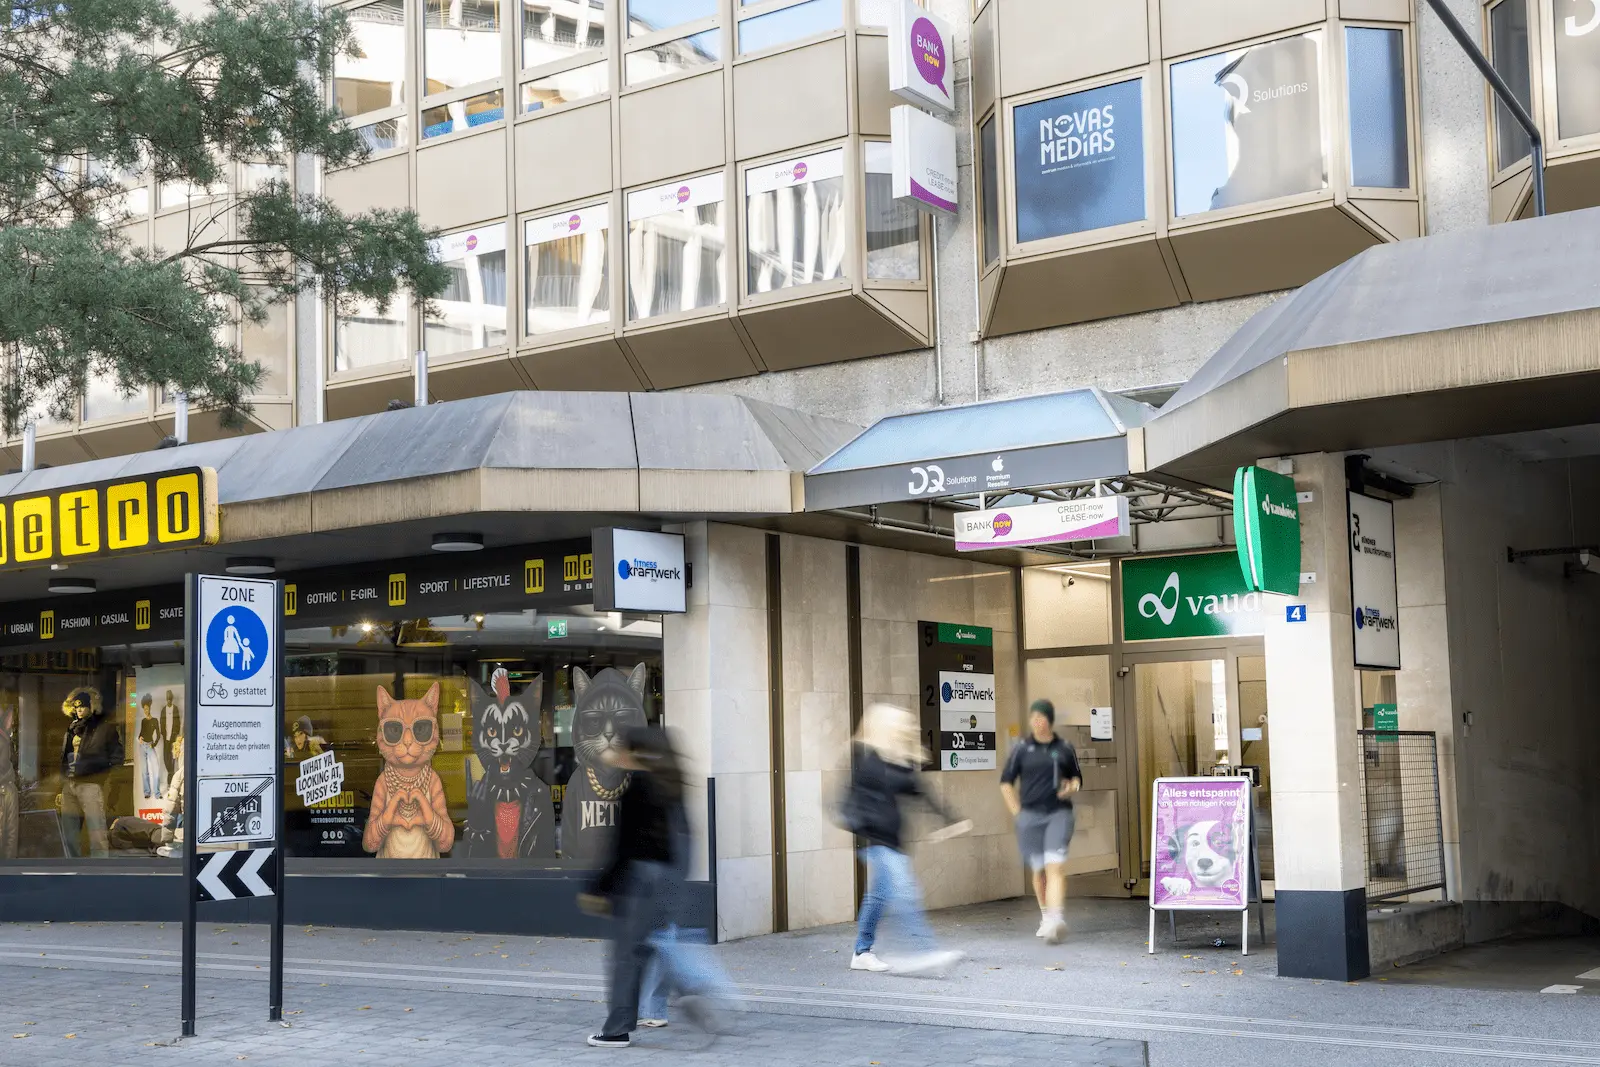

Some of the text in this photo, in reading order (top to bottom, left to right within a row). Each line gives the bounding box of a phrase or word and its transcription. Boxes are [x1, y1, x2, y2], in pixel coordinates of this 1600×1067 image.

[916, 34, 940, 57] BANK
[924, 53, 940, 68] now
[1254, 82, 1308, 102] Solutions
[774, 169, 792, 178] BANK
[552, 222, 568, 230] BANK
[946, 475, 977, 486] Solutions
[986, 474, 1010, 482] Premium
[1057, 503, 1104, 514] CREDIT-now
[1061, 513, 1105, 523] LEASE-now
[0, 491, 190, 557] etro
[966, 519, 1012, 532] BANK now
[221, 586, 255, 602] ZONE
[307, 592, 337, 604] GOTHIC
[350, 588, 378, 600] E-GIRL
[420, 581, 449, 594] SPORT
[464, 575, 510, 590] LIFESTYLE
[1290, 606, 1301, 620] 4
[11, 623, 34, 634] URBAN
[61, 617, 90, 629] FASHION
[101, 613, 129, 624] CASUAL
[160, 607, 183, 619] SKATE
[234, 688, 267, 698] gestattet
[212, 720, 261, 730] Ausgenommen
[206, 732, 248, 741] Güterumschlag
[248, 743, 270, 751] privaten
[206, 753, 238, 762] Parkplätzen
[303, 755, 333, 776] WHAT YA
[298, 770, 329, 792] LOOKING
[225, 782, 249, 793] ZONE
[306, 784, 328, 803] PUSSY
[1163, 788, 1240, 799] Alles entspannt
[252, 820, 260, 830] 20
